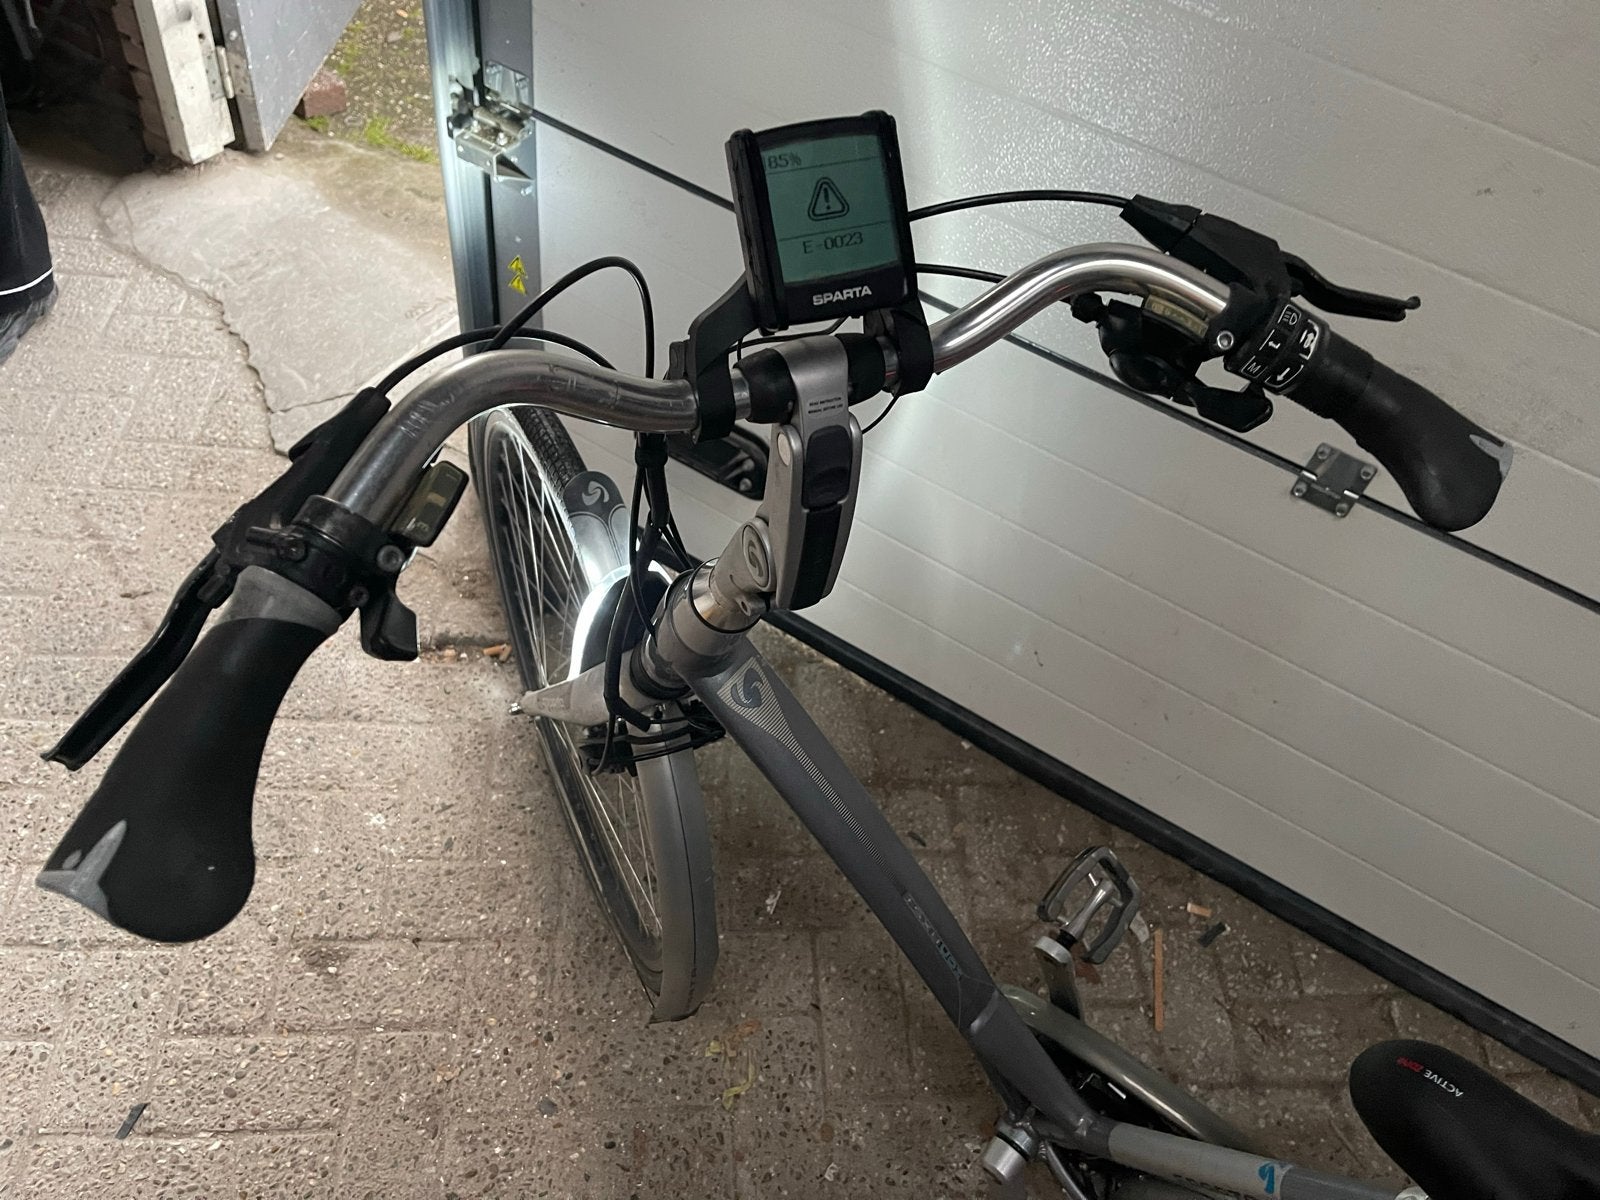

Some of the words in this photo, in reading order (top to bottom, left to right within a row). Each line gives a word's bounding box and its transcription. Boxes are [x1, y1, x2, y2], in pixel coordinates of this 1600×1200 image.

[767, 151, 802, 169] 85%
[812, 285, 873, 306] SPARTA
[1247, 361, 1262, 374] M
[1423, 1069, 1464, 1097] ACTIVE
